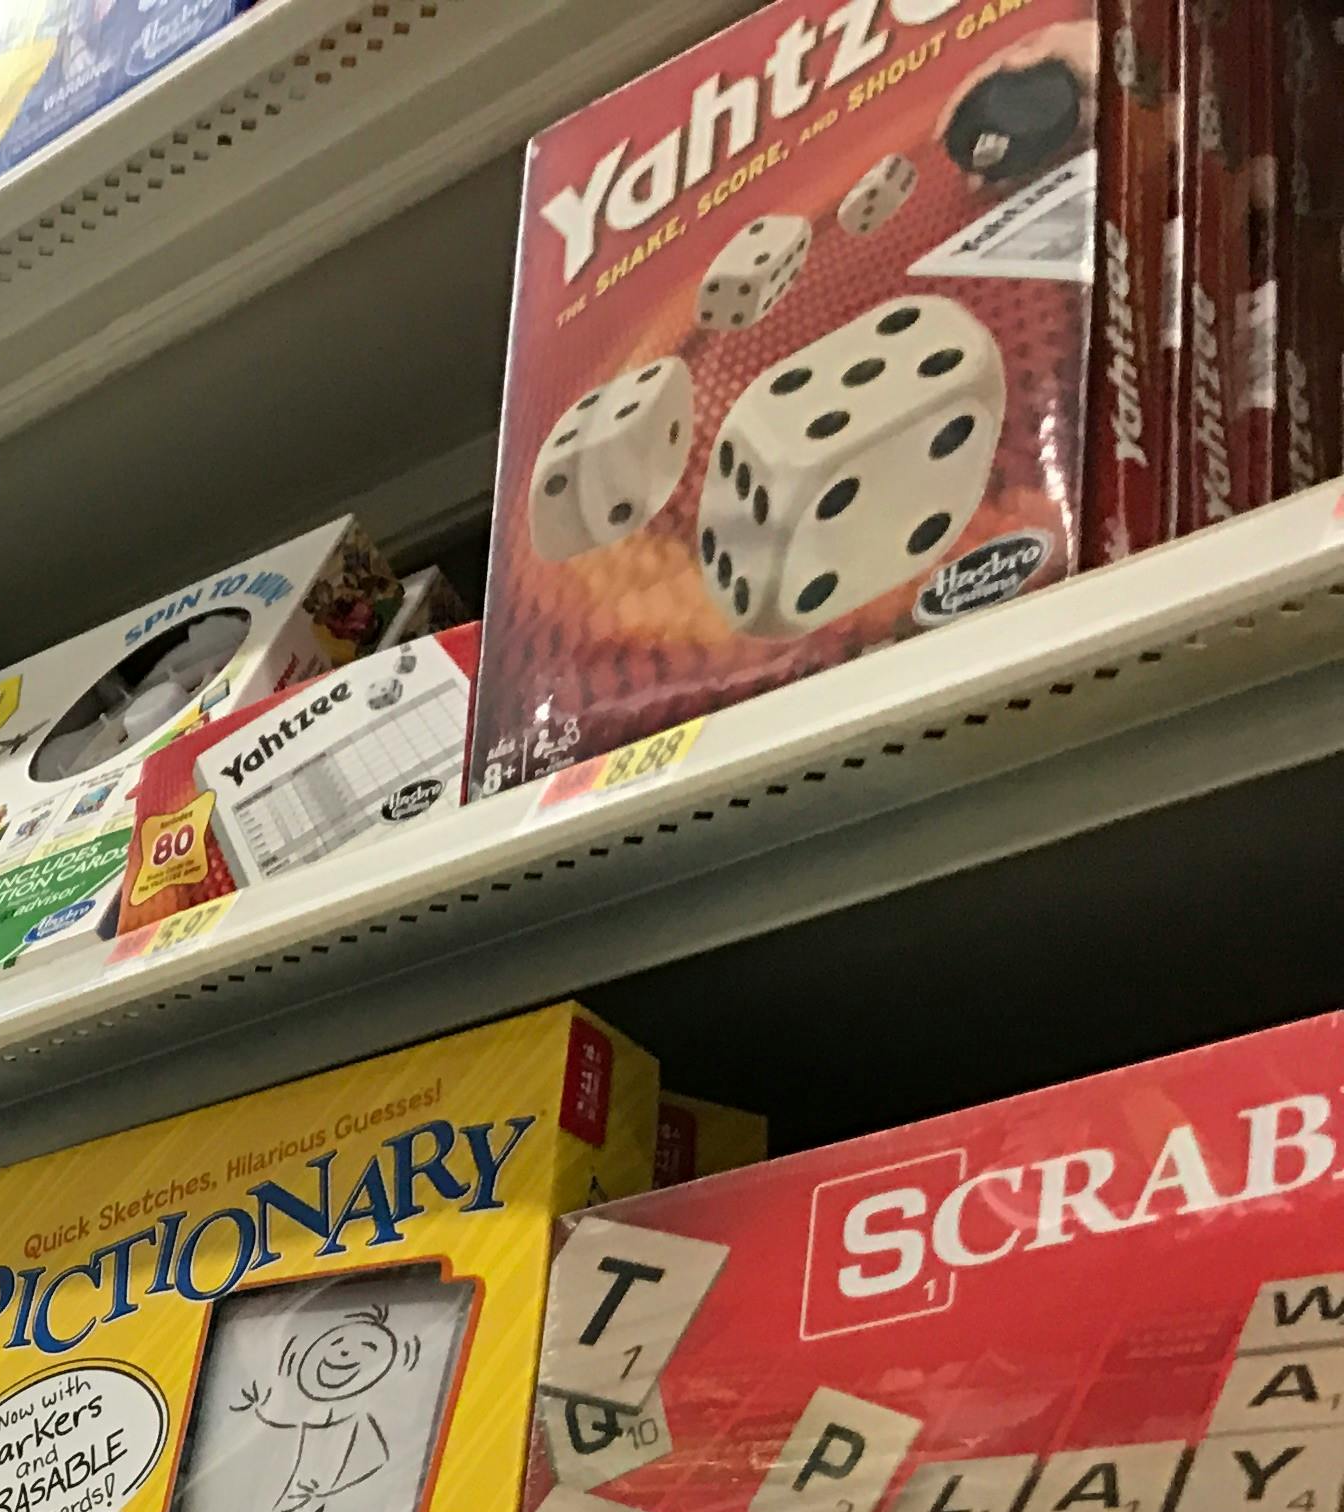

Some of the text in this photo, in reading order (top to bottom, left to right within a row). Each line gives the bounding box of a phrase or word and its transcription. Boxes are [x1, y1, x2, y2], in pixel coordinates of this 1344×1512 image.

[541, 0, 962, 284] Yahtz
[556, 295, 589, 331] THE
[595, 214, 687, 296] SHAKE,
[696, 144, 790, 215] SCORE,
[798, 109, 840, 147] AND
[846, 38, 944, 116] SHOUT
[1105, 220, 1149, 467] Yahtzee
[934, 542, 1041, 597] Hasbro
[123, 573, 249, 647] SPIN TO
[219, 679, 353, 788] Yahtzee
[483, 762, 514, 793] 8+
[56, 846, 128, 881] CARDS
[152, 824, 195, 865] 80
[23, 1078, 444, 1261] Quick Sketches, Hilarious Guesses!
[576, 1257, 666, 1346] T
[42, 1375, 91, 1408] with
[16, 1443, 59, 1479] and
